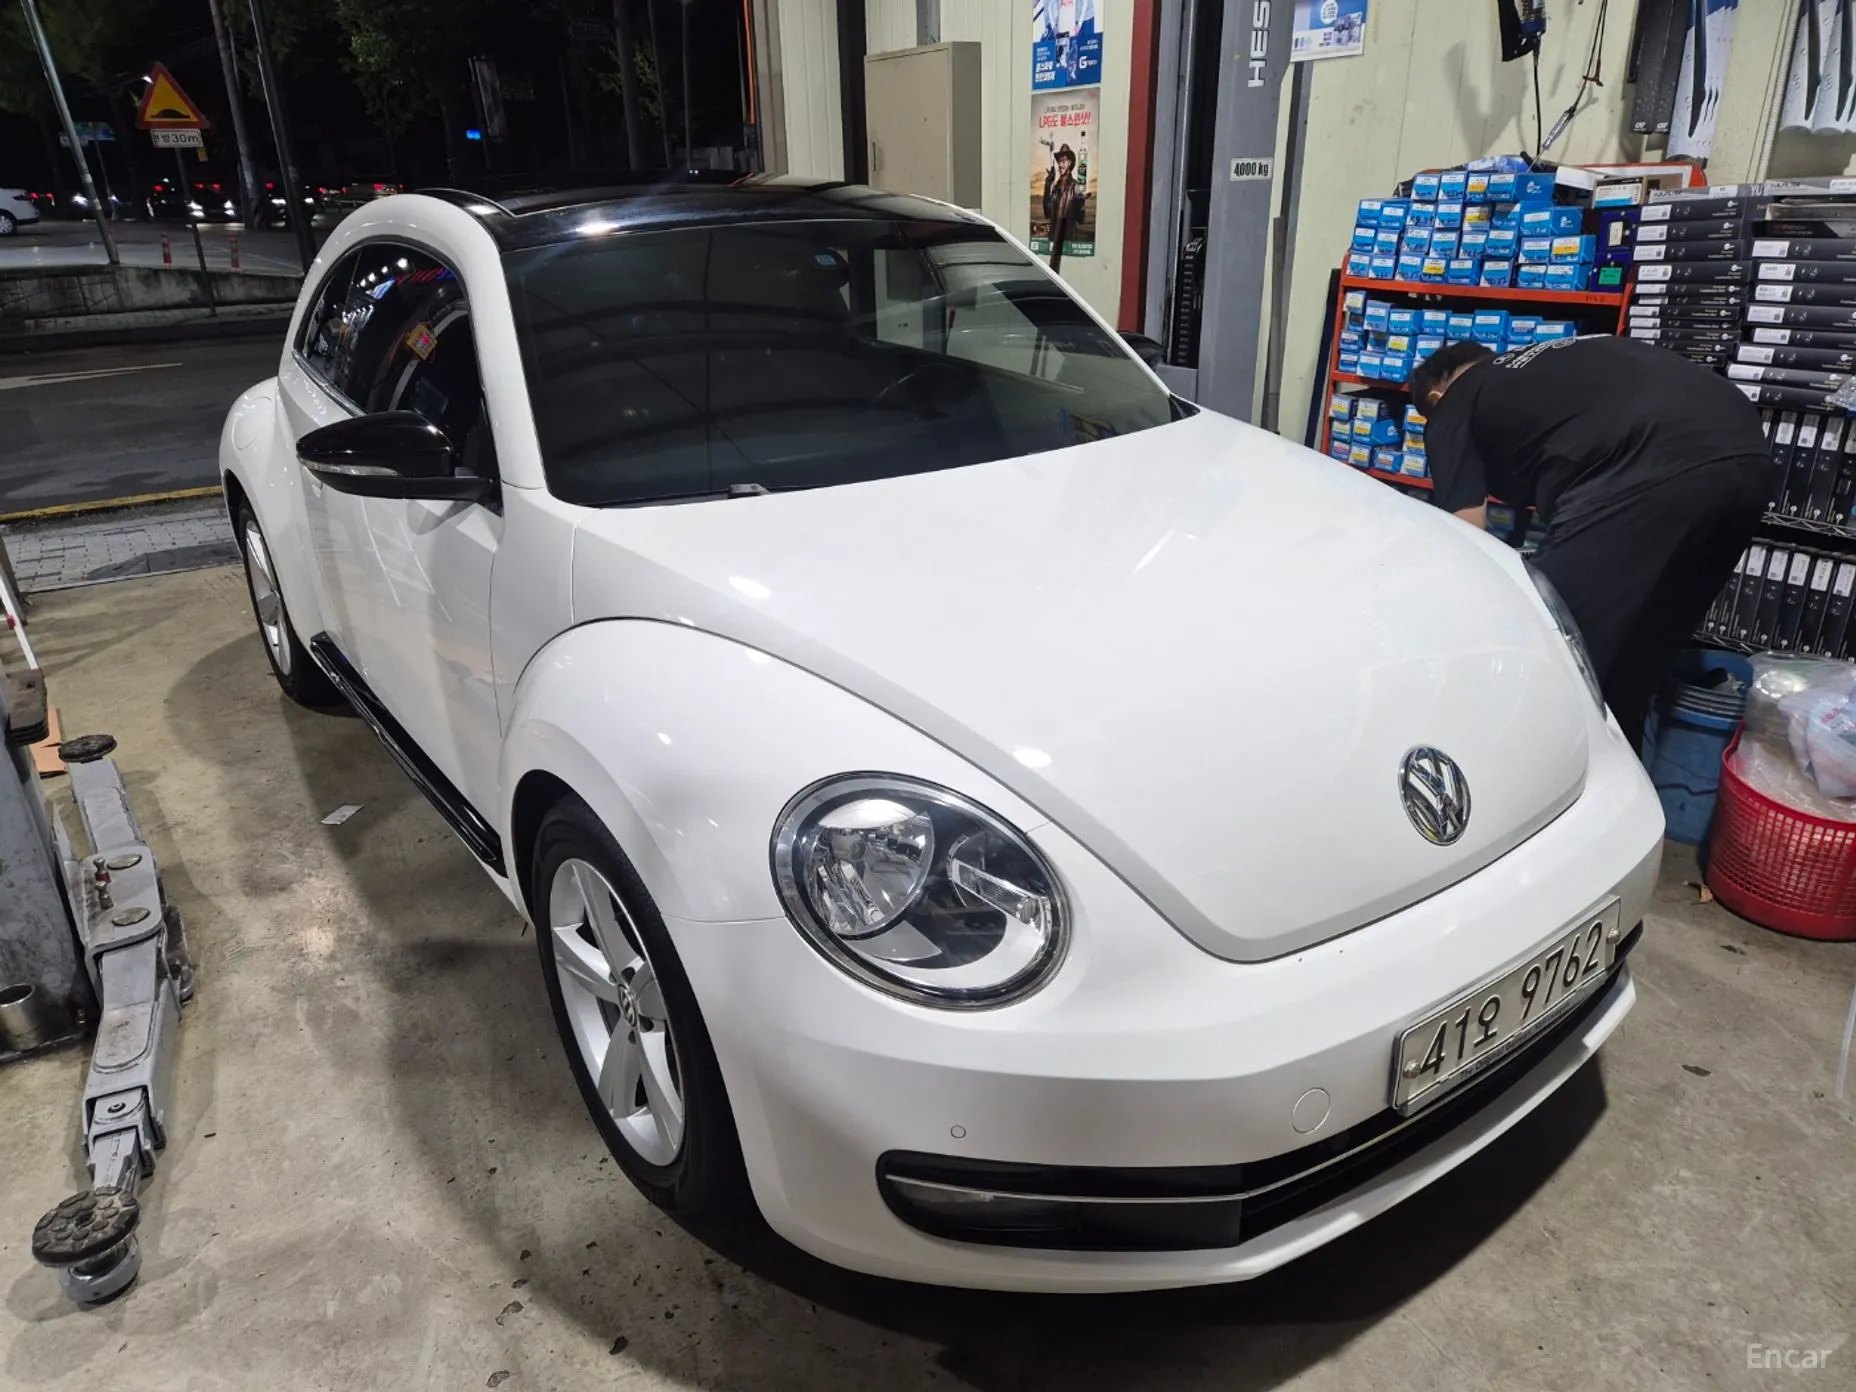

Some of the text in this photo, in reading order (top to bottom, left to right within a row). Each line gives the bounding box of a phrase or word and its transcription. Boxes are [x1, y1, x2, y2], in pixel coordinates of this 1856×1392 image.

[1258, 162, 1268, 176] kg
[1419, 921, 1603, 1075] 41오 9762
